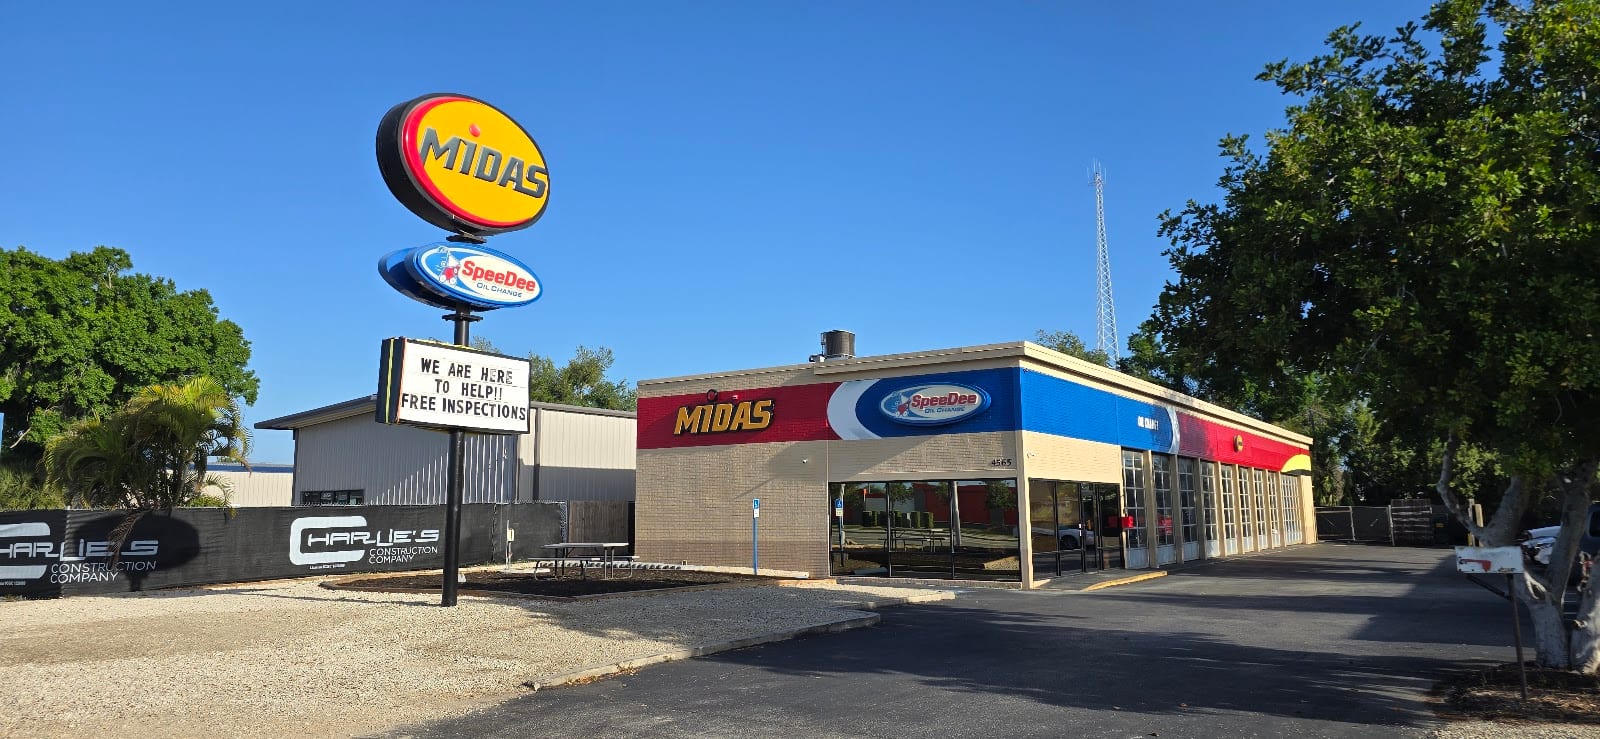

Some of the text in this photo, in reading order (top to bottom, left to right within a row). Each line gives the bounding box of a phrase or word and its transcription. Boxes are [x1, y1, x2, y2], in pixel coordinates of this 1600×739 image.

[420, 126, 549, 198] MIDAS
[462, 260, 536, 292] SpeeDee
[476, 282, 523, 298] OIL CHANGE
[421, 357, 513, 385] WE ARE HERE
[435, 378, 503, 401] TO HELP!!
[911, 392, 978, 409] SpeeDee
[401, 393, 526, 421] FREE INSPECTIONS
[673, 398, 773, 436] MIDAS
[991, 457, 1012, 467] 4565
[289, 515, 440, 566] CHARLIE'S
[369, 546, 438, 557] CONSTRUCTION
[368, 554, 415, 564] COMPANY
[50, 571, 119, 584] COMPANY
